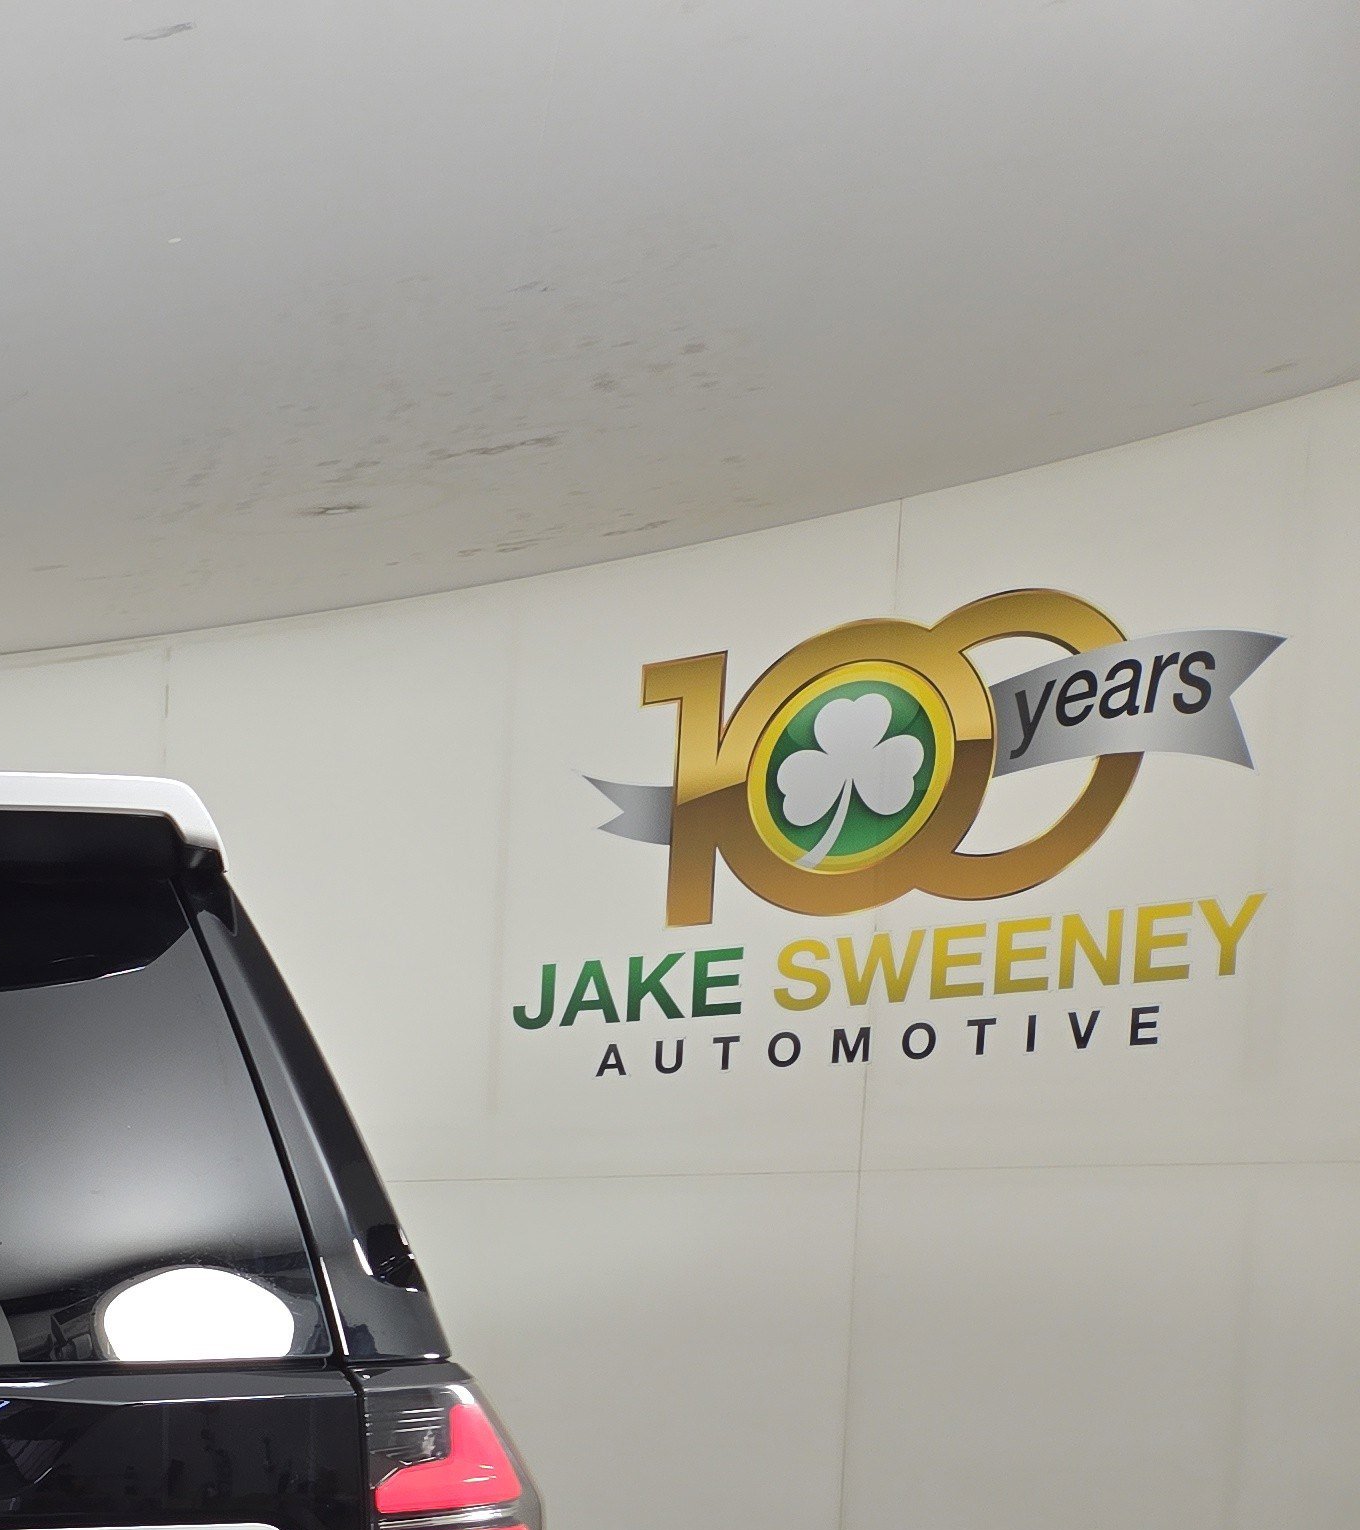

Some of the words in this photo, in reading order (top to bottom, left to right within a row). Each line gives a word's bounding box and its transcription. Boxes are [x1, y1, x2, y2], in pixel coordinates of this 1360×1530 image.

[641, 587, 1145, 928] 100
[1009, 648, 1218, 760] years
[512, 945, 745, 1030] JAKE
[773, 892, 1266, 1011] SWEENEY
[595, 1003, 1161, 1078] AUTOMOTIVE
